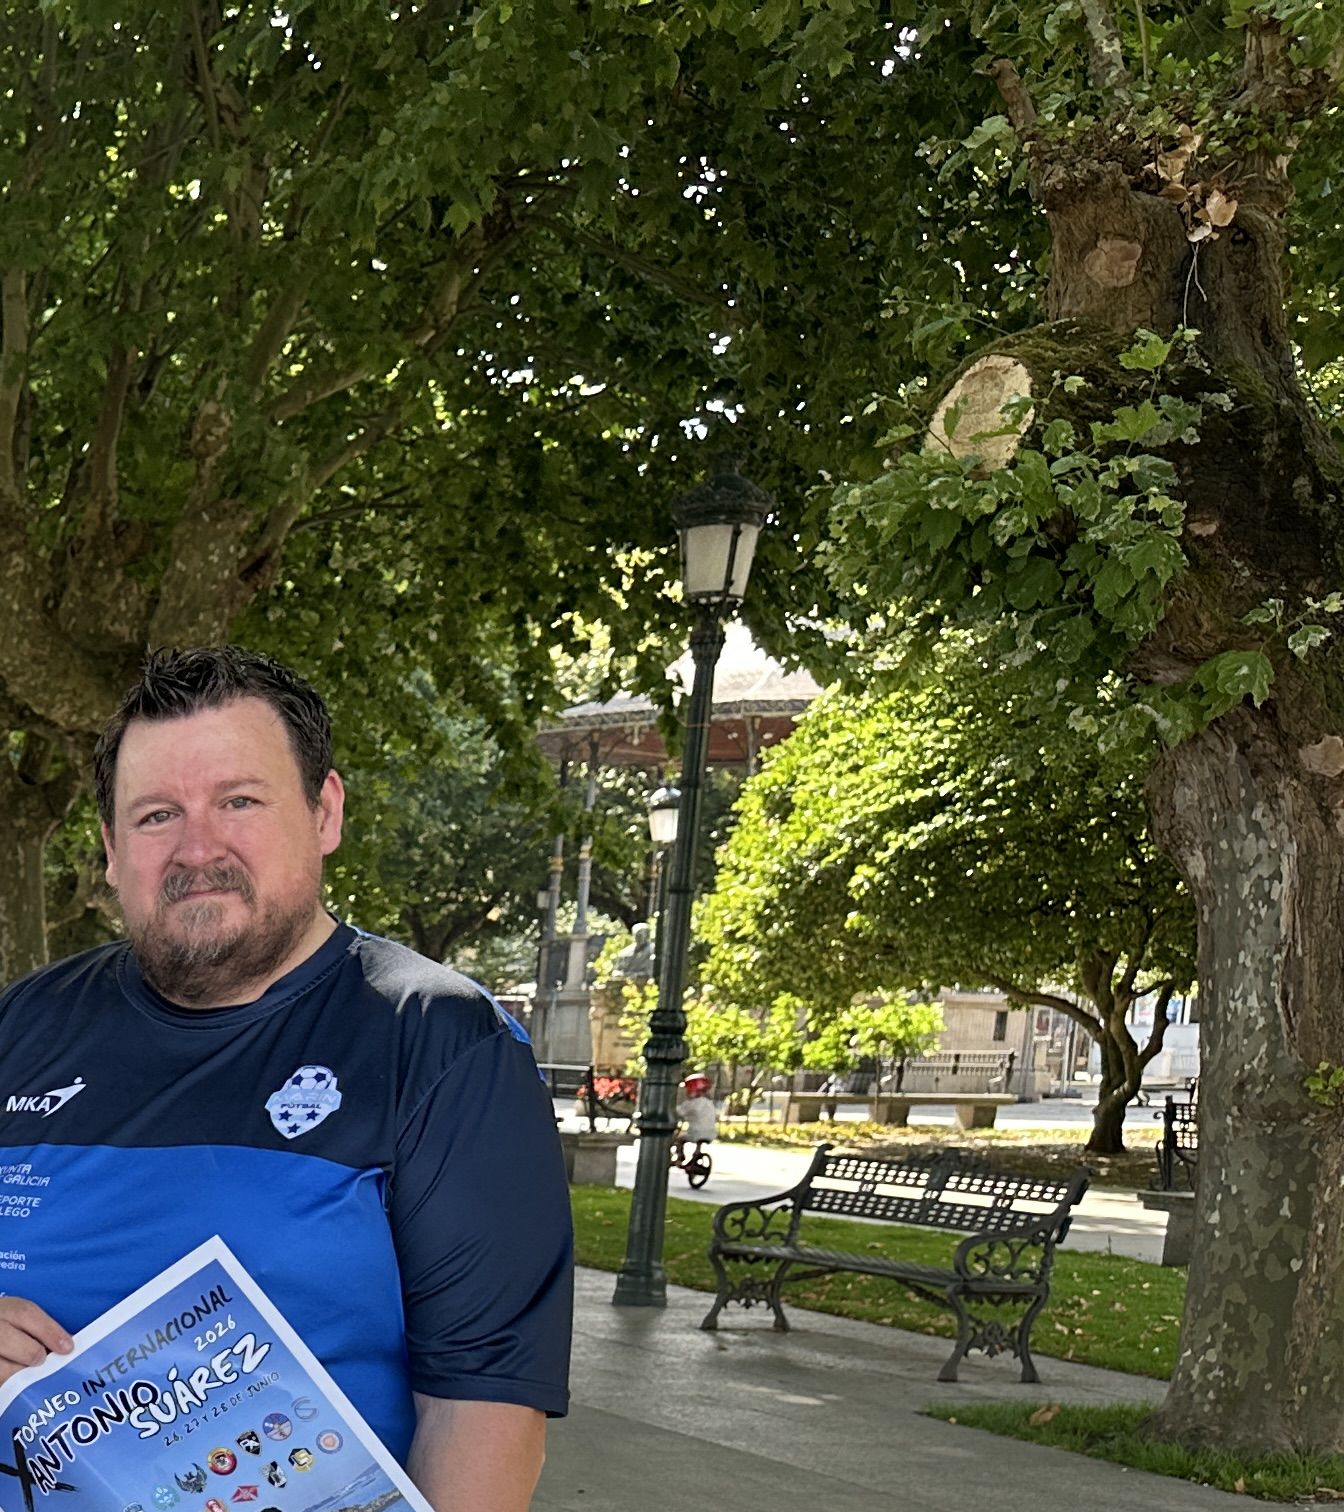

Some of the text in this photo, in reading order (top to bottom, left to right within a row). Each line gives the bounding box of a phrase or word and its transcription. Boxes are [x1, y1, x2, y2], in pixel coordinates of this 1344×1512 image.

[5, 1095, 51, 1112] MKA
[2, 1174, 50, 1187] GALICIA
[193, 1313, 236, 1352] 2026
[13, 1284, 233, 1450] TORNEO INTERNACIONAL
[129, 1332, 273, 1440] SUÁREZ
[248, 1371, 280, 1398] JUNIO
[27, 1380, 161, 1496] ANTONIO
